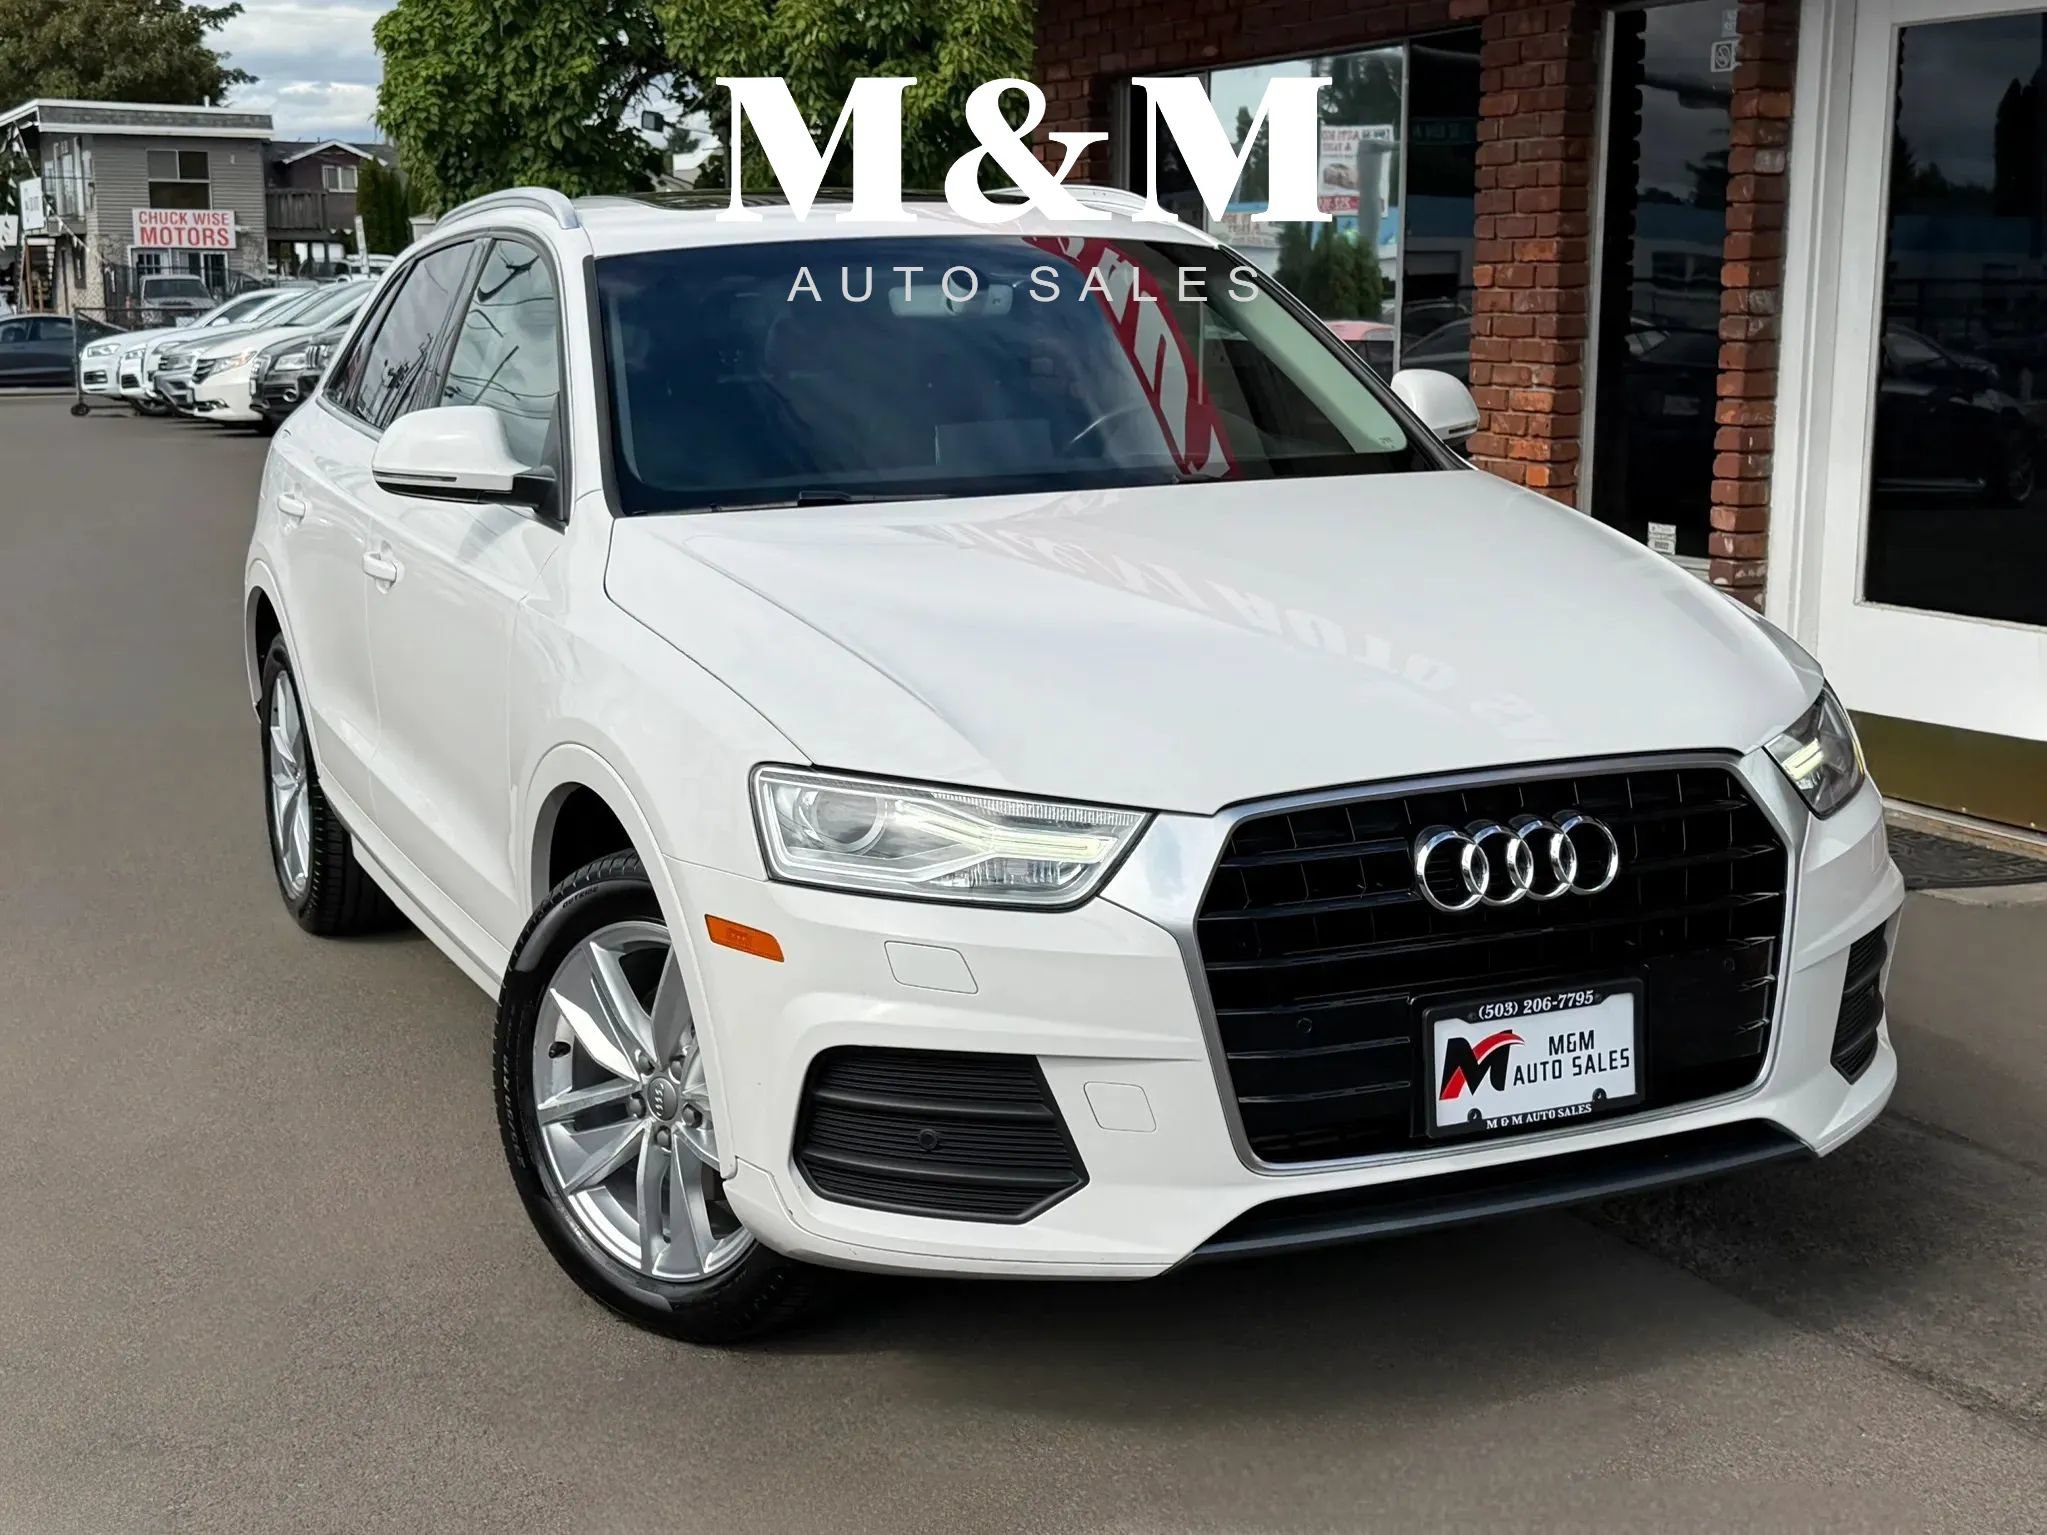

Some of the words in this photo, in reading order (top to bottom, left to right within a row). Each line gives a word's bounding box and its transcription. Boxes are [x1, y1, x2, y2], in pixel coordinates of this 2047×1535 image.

[138, 210, 188, 225] CHUCK
[193, 212, 229, 226] WISE
[140, 226, 229, 246] MOTORS
[1478, 1003, 1518, 1020] (503)
[1523, 990, 1594, 1014] 206-7795
[1548, 1029, 1595, 1056] M&M
[1513, 1059, 1562, 1086] AUTO
[1573, 1048, 1630, 1077] SALES
[1526, 1109, 1556, 1124] AUTO
[1558, 1103, 1592, 1118] SALES
